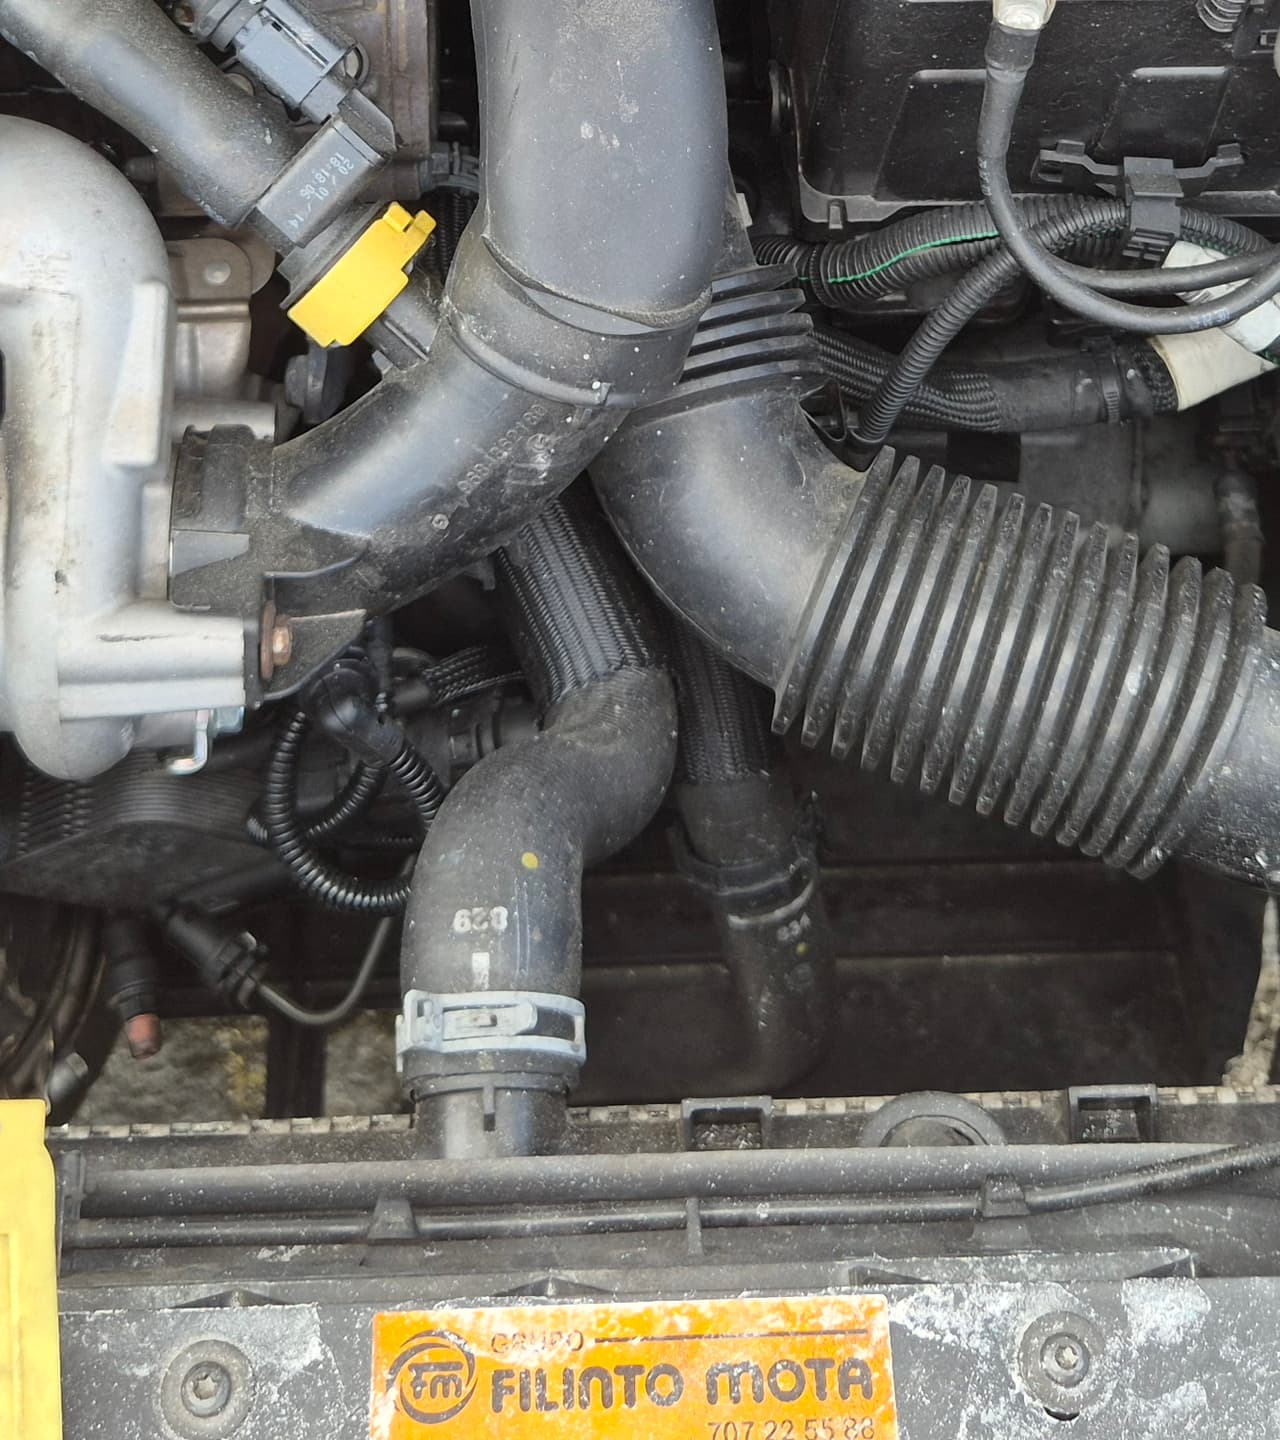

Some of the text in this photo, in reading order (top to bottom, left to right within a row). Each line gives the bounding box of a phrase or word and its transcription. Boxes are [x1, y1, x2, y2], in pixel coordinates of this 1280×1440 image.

[491, 1330, 584, 1354] GRUPO
[491, 1357, 873, 1413] FILINTO MOTA
[708, 1421, 754, 1440] 707
[765, 1420, 794, 1440] 22
[804, 1418, 835, 1440] 55
